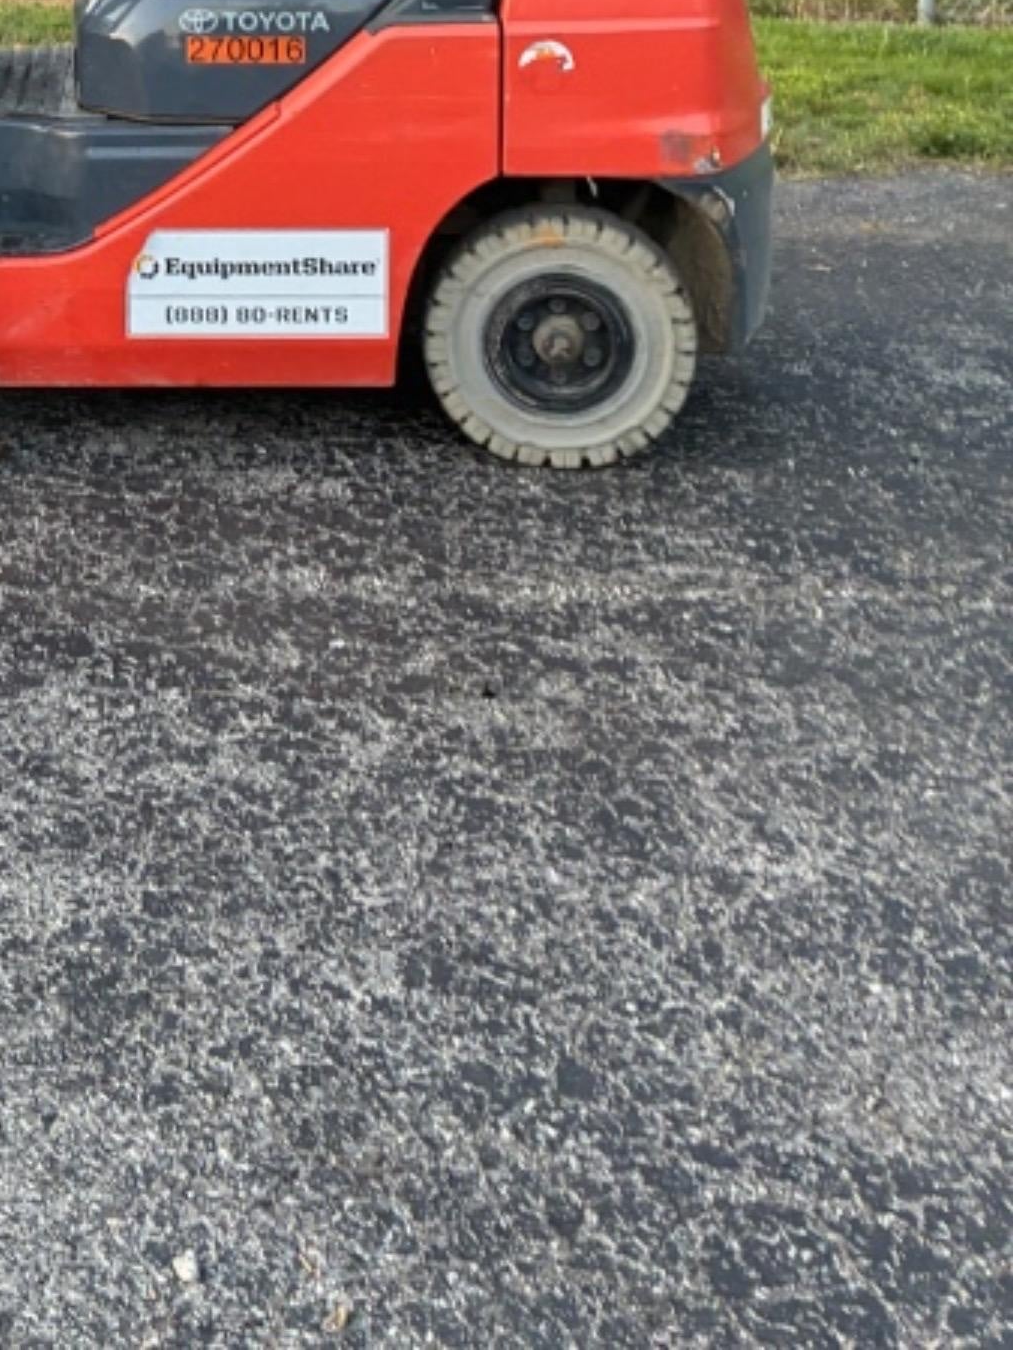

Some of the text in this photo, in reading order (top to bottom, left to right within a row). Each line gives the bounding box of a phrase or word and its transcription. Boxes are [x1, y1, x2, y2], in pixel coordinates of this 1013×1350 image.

[221, 10, 331, 33] TOYOTA
[189, 36, 304, 62] 270016
[164, 256, 377, 280] EquipmentShare
[165, 305, 349, 325] (888) 80-RENTS
